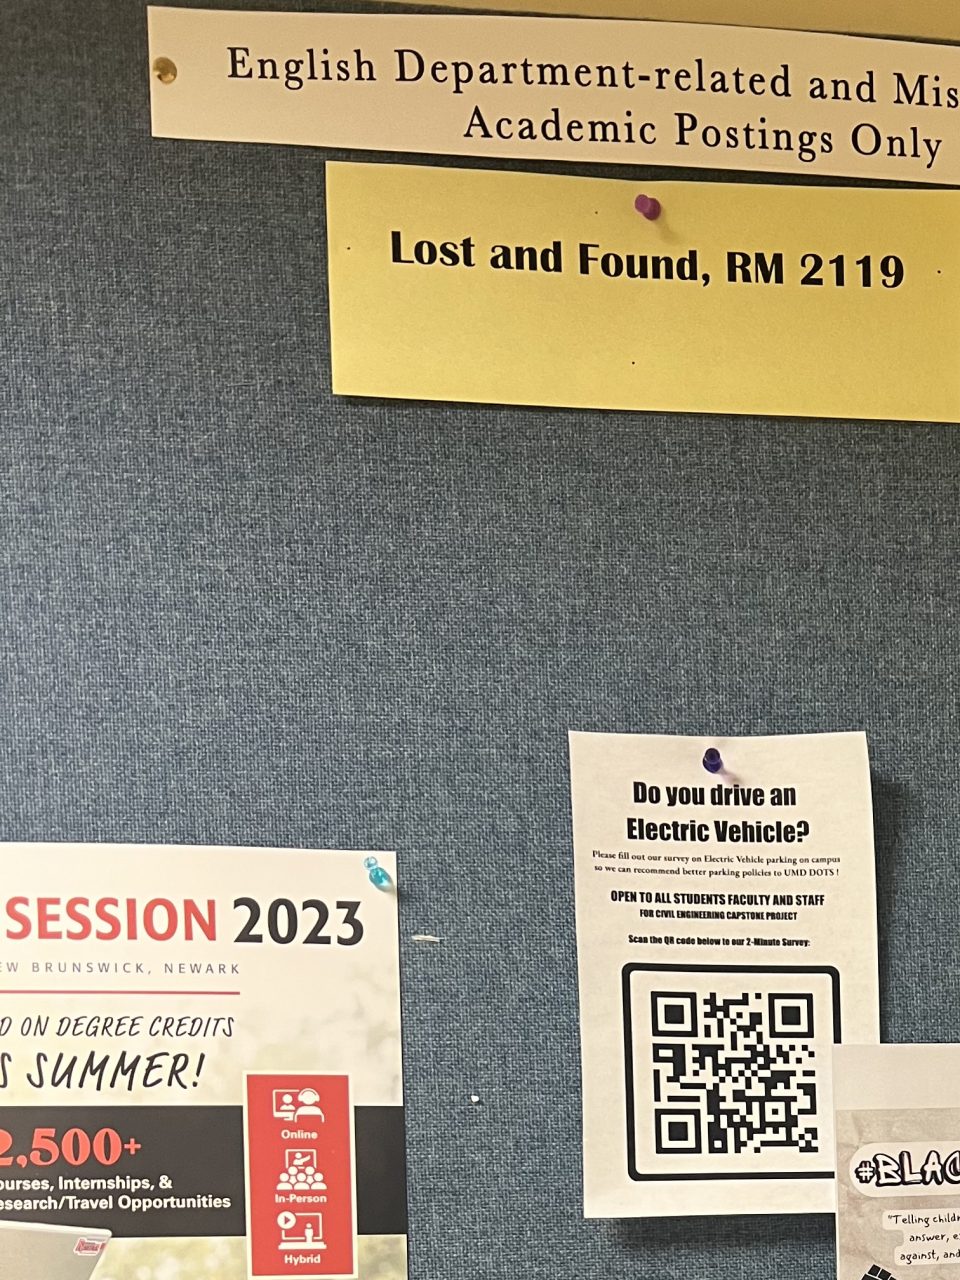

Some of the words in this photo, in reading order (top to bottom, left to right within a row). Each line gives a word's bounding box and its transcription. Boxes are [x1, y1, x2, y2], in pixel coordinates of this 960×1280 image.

[227, 47, 376, 90] English
[394, 49, 791, 97] Department-related
[809, 71, 876, 103] and
[464, 105, 656, 144] Academic
[674, 113, 833, 162] Postings
[852, 123, 942, 168] Only
[391, 231, 475, 267] Lost
[490, 241, 562, 272] and
[579, 243, 710, 287] Found,
[727, 252, 783, 284] RM
[801, 254, 904, 288] 2119
[633, 781, 661, 804] Do
[665, 786, 705, 807] you
[710, 784, 765, 806] drive
[770, 787, 796, 806] an
[627, 817, 709, 842] Electric
[714, 820, 809, 843] Vehicle?
[611, 890, 637, 902] OPEN
[639, 892, 652, 903] TO
[655, 892, 672, 904] ALL
[673, 893, 726, 905] STUDENTS
[728, 894, 771, 906] FACULTY
[773, 894, 793, 906] AND
[795, 895, 825, 906] STAFF
[6, 897, 216, 941] SESSION
[233, 897, 364, 946] 2023
[32, 962, 151, 975] BRUNSWICK,
[164, 963, 239, 974] NEWARK
[21, 1015, 50, 1036] ON
[56, 1016, 144, 1037] DEGREE
[149, 1016, 234, 1037] CREDITS
[26, 1050, 205, 1091] SUMMER!
[281, 1129, 318, 1139] Online
[275, 1193, 327, 1203] In-Person
[284, 1254, 321, 1266] Hybrid
